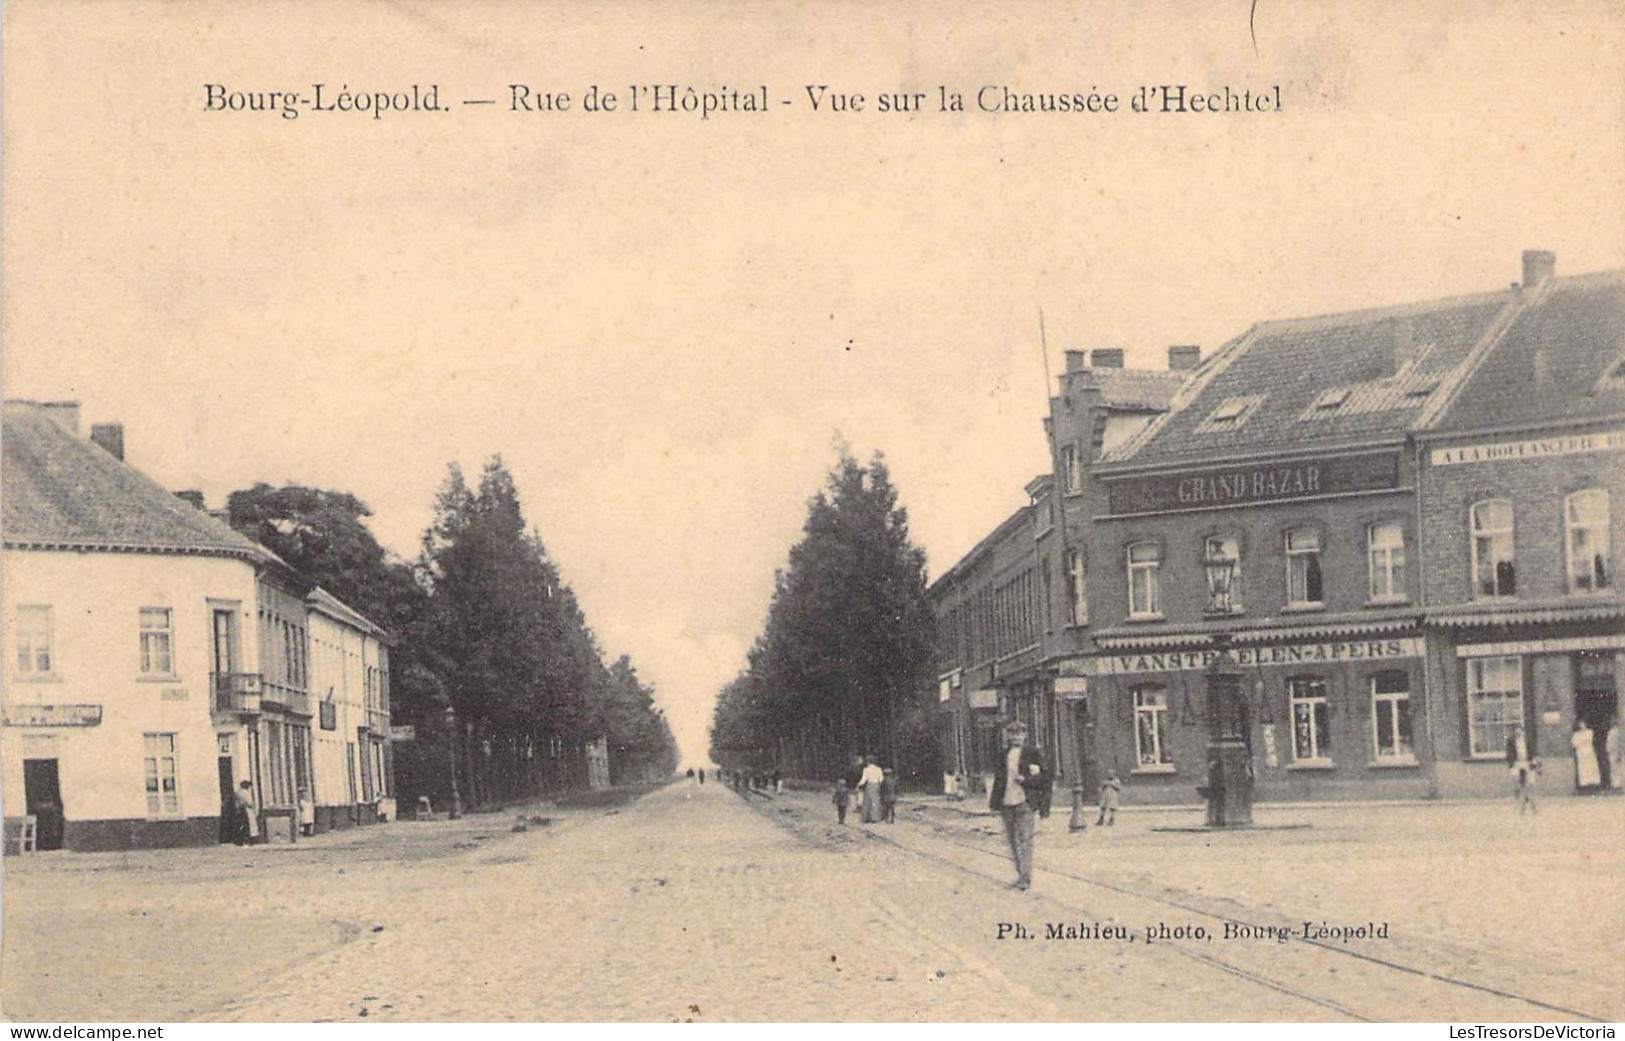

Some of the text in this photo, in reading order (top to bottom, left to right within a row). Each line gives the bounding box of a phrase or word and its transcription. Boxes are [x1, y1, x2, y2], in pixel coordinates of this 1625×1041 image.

[1178, 475, 1246, 503] GRAND
[1252, 466, 1321, 497] BAZAR
[1119, 641, 1405, 671] VANSTRELEN-APERS.
